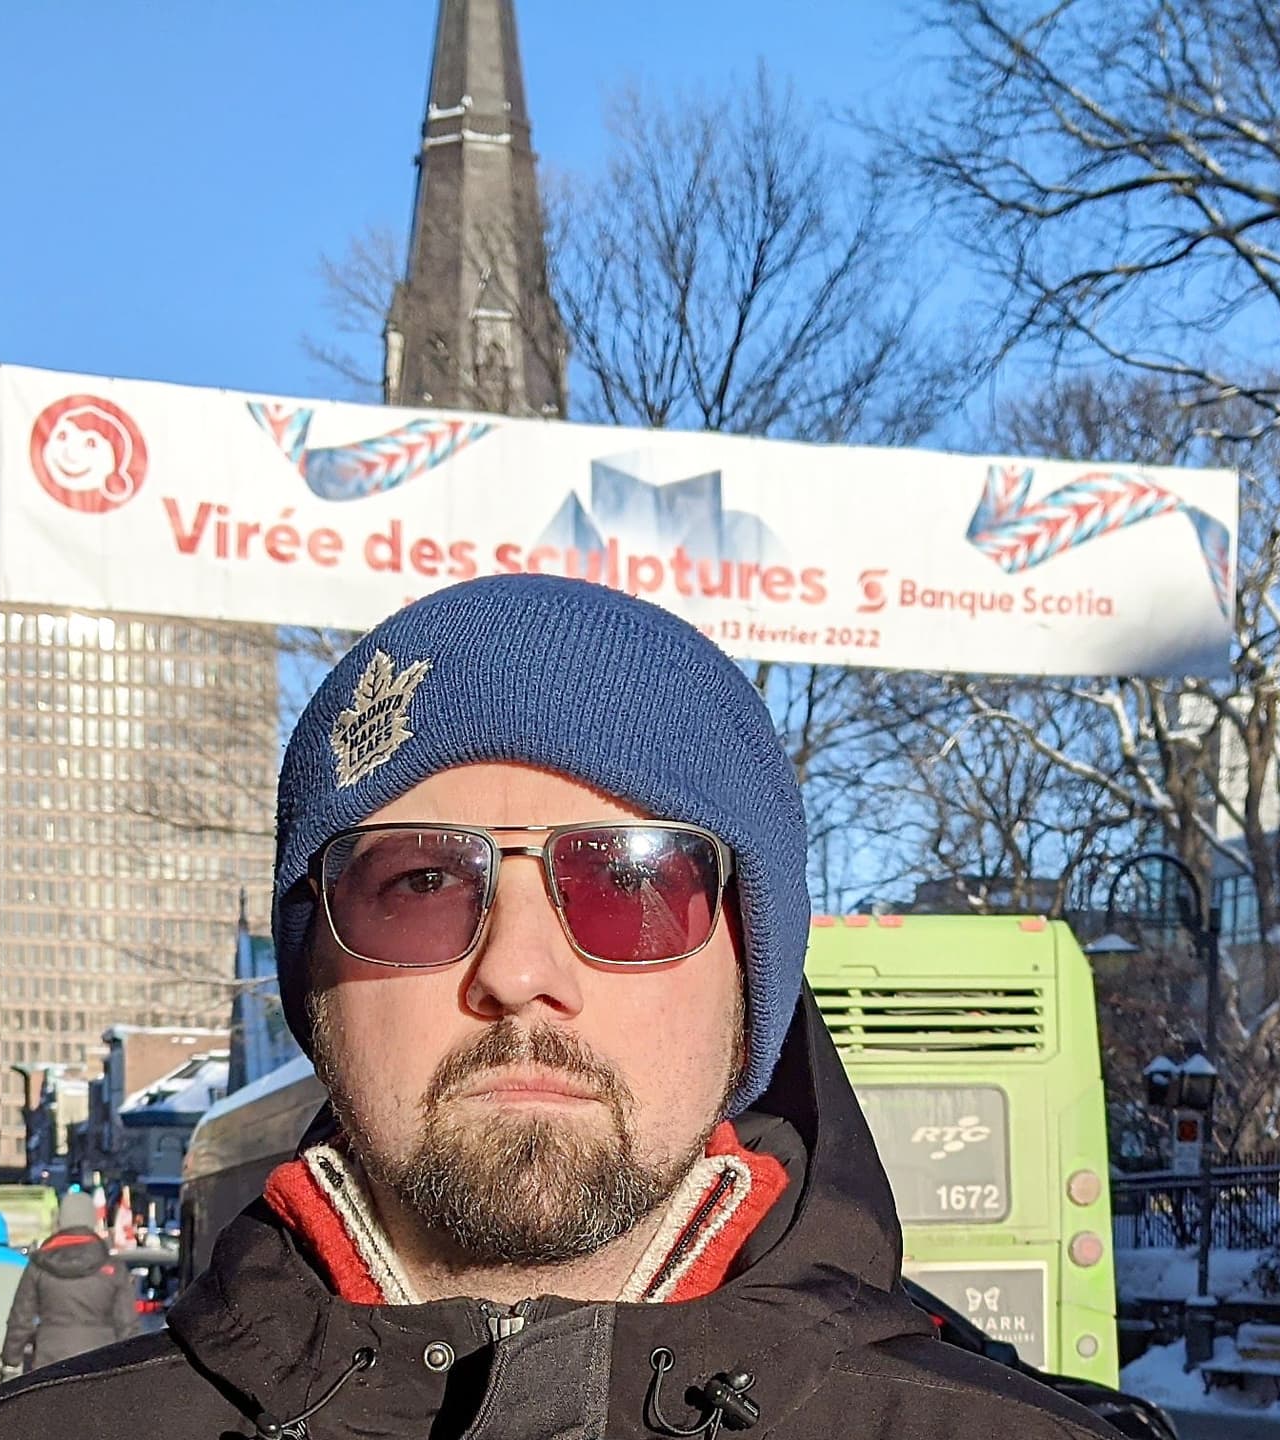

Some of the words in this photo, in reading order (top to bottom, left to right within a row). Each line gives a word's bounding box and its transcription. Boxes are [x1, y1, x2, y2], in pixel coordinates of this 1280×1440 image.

[161, 497, 344, 566] Virée
[364, 519, 477, 578] des
[495, 537, 828, 605] sculptures
[899, 579, 1014, 618] Banque
[1023, 586, 1113, 616] Scotia
[721, 620, 741, 640] 13
[748, 623, 818, 645] février
[825, 627, 881, 648] 2022
[340, 693, 404, 745] TORONTO
[348, 712, 393, 752] MAPLE
[348, 727, 393, 767] LEAFS
[911, 1125, 991, 1143] RTC
[936, 1184, 1000, 1211] 1672
[969, 1315, 1026, 1331] NARK
